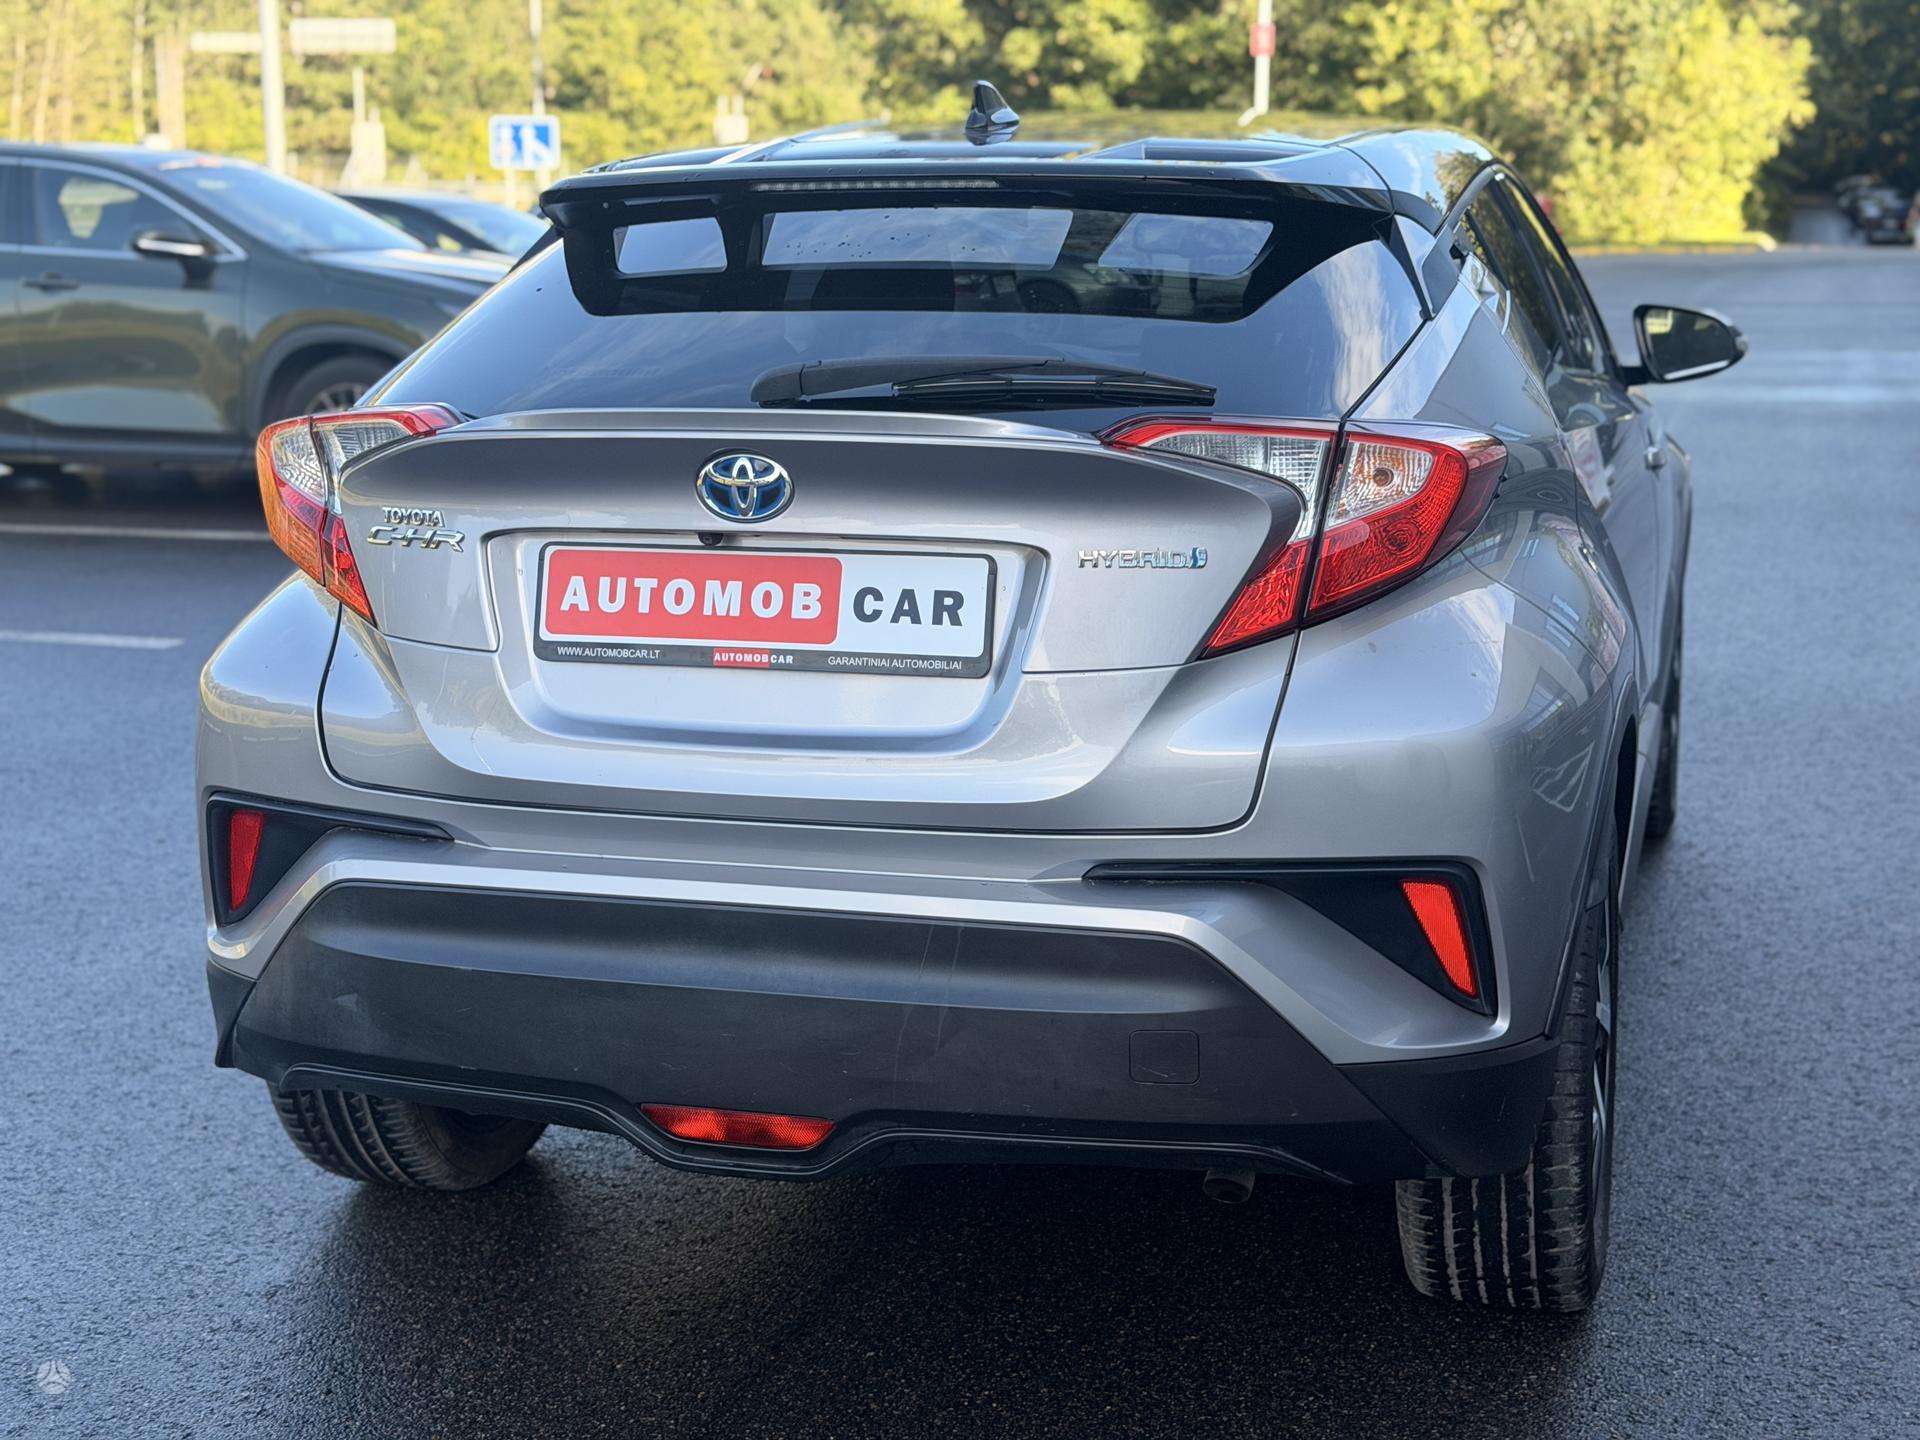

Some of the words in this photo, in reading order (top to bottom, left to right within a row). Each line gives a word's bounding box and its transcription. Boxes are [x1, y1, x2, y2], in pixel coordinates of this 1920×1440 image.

[382, 507, 445, 527] TOYOTA
[1078, 549, 1186, 568] HYBRID
[560, 575, 822, 619] AUTOMOB
[853, 586, 965, 627] CAR
[557, 646, 661, 659] WWW.AUTOMOBCAR.LT
[827, 656, 890, 668] GARANTINIAI
[891, 658, 963, 670] AUTOMOBILIAI
